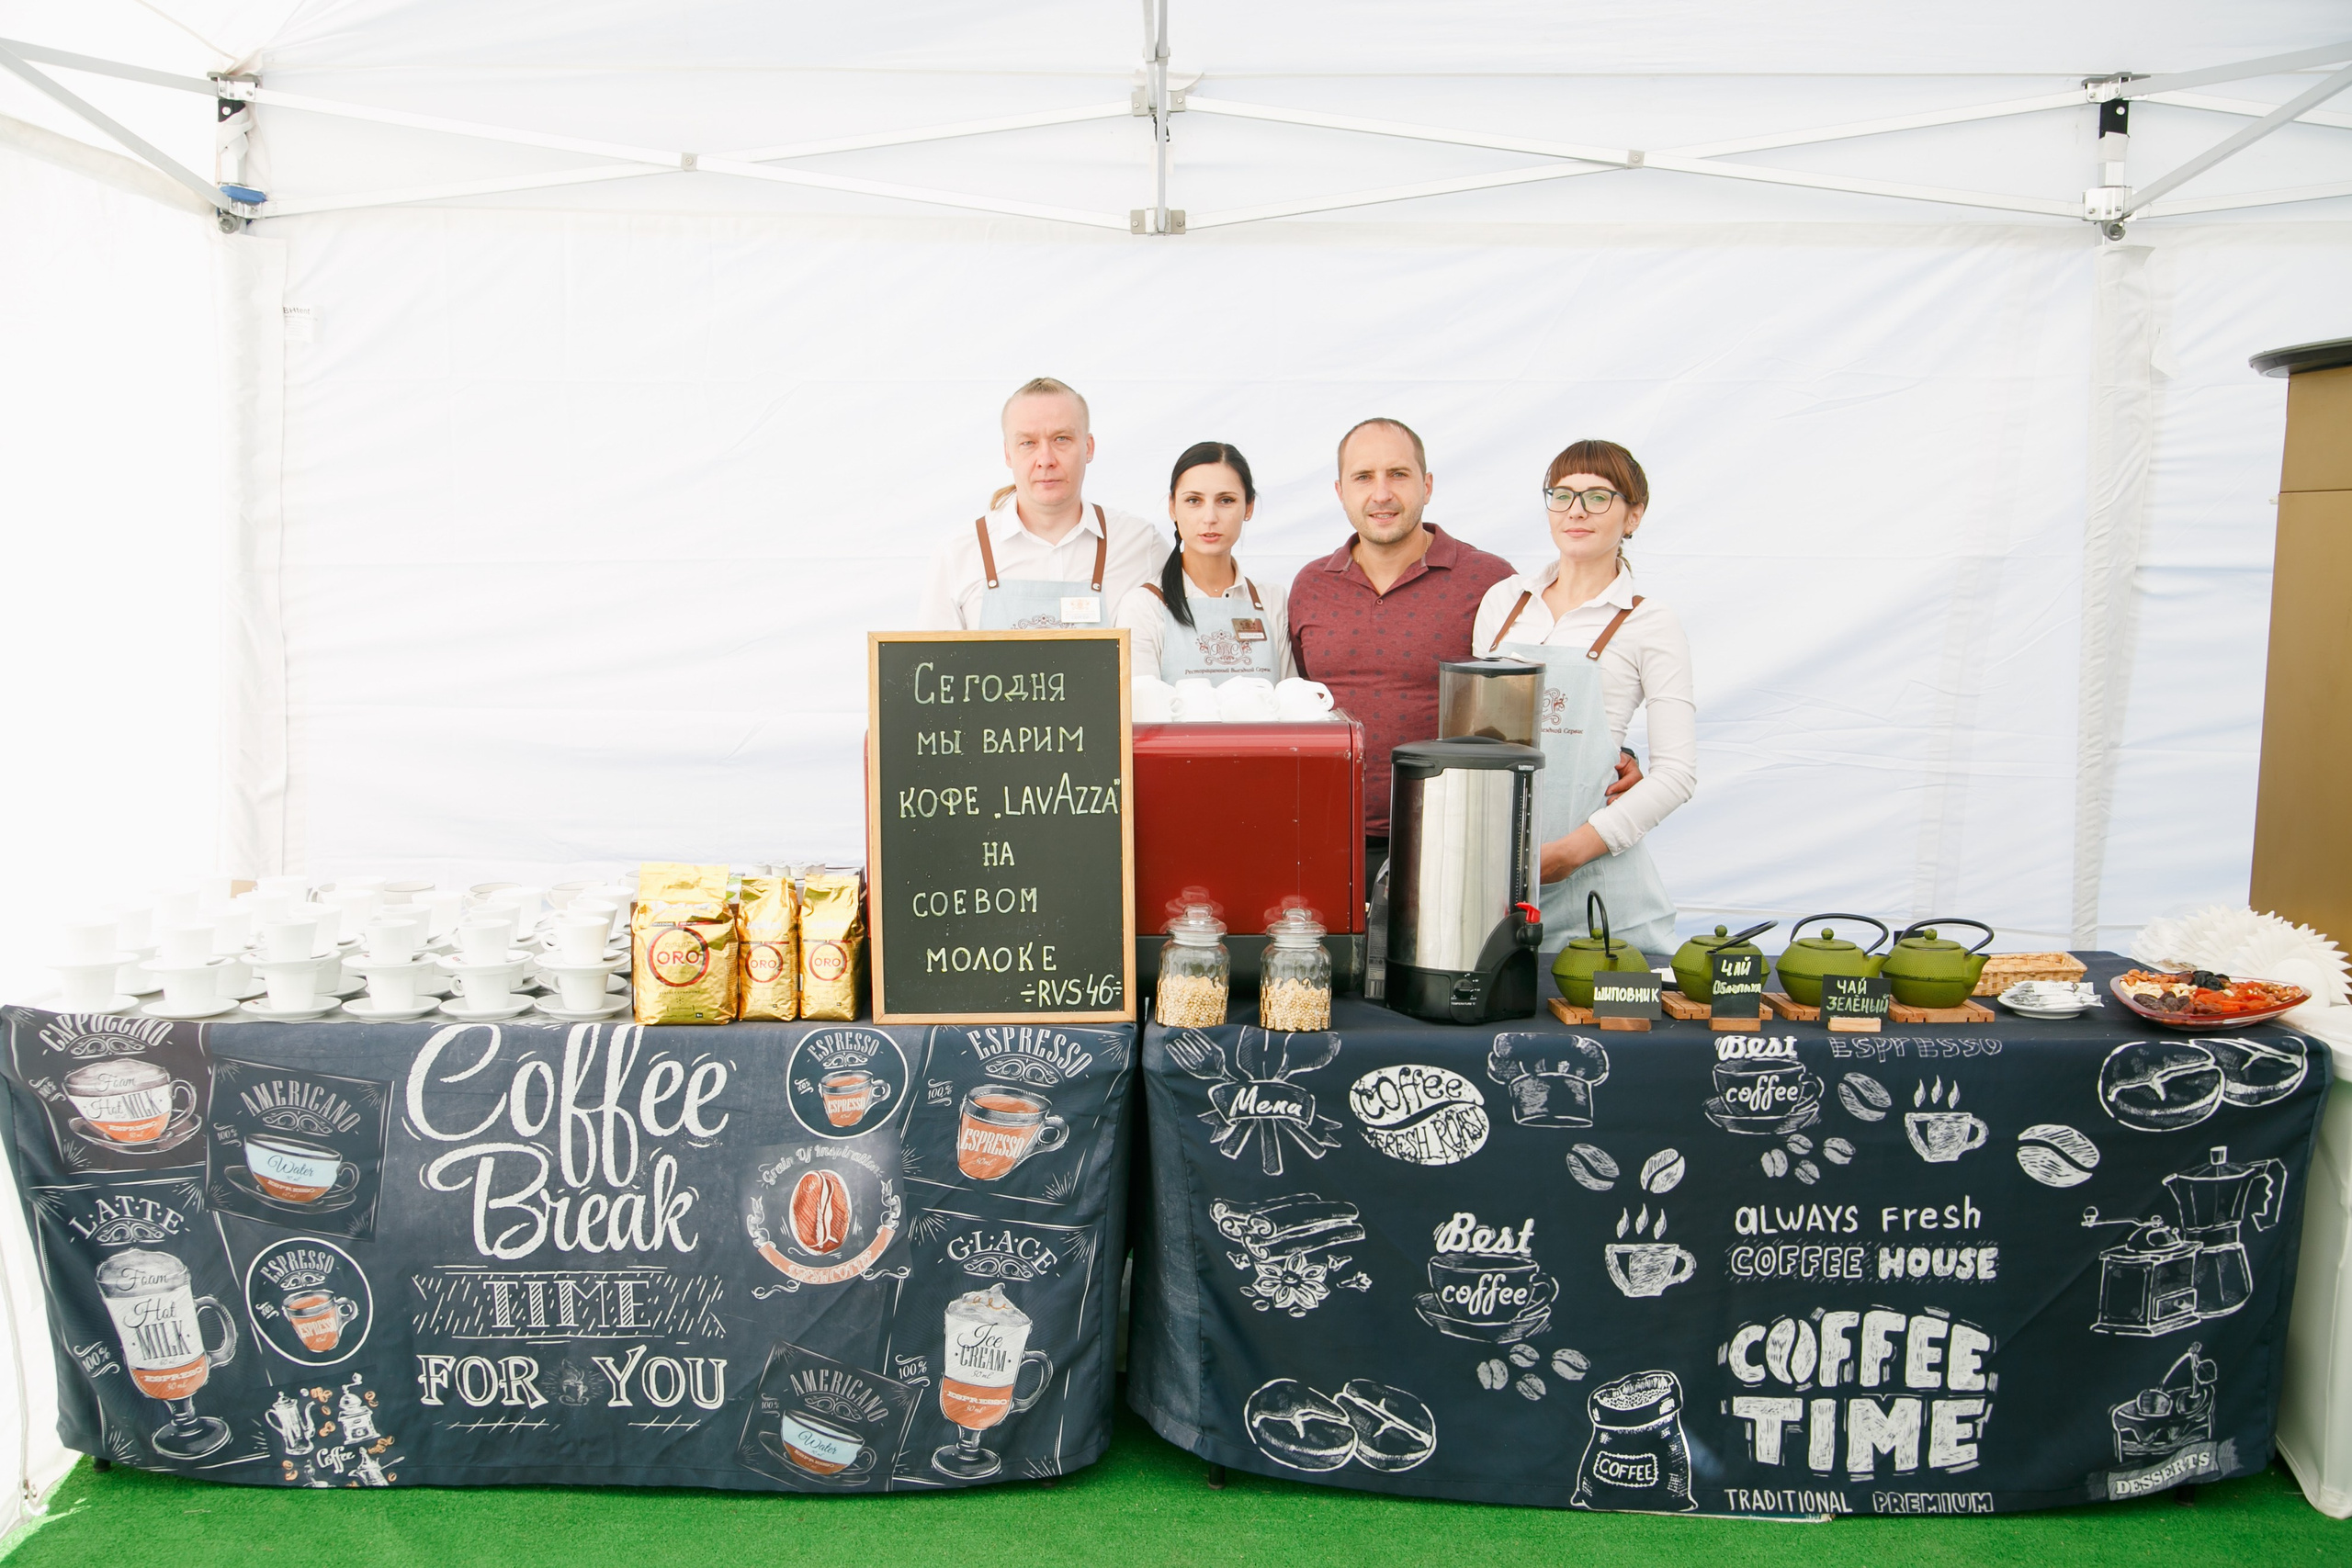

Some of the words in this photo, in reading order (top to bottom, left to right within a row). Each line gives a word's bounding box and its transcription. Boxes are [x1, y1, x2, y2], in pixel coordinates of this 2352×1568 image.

[657, 950, 699, 965] ORO
[751, 959, 776, 968] ORO
[814, 957, 841, 967] ORO
[1721, 956, 1751, 976] ЧАЙ
[1593, 987, 1660, 1003] ШИПОВНИК
[1837, 976, 1867, 994] ЧАЙ
[807, 1032, 880, 1063] ESPRESSO
[967, 1026, 1092, 1078] ESPRESSO
[1716, 1035, 1798, 1060] Best
[95, 1073, 137, 1092] Foam
[927, 1086, 953, 1100] 100%
[1725, 1075, 1799, 1111] coffee
[85, 1099, 123, 1119] Hot
[122, 1089, 162, 1119] MILK
[240, 1080, 361, 1133] AMERICANO
[406, 1023, 729, 1188] Coffee
[828, 1097, 865, 1114] ESPRESSO
[217, 1128, 238, 1141] 100%
[960, 1128, 1025, 1159] ESPRESSO
[267, 1155, 314, 1177] Water
[762, 1156, 794, 1185] Grain
[427, 1142, 699, 1259] Break
[1435, 1213, 1535, 1256] Best
[260, 1249, 335, 1284] ESPRESSO
[1731, 1245, 1864, 1279] COFFEE
[1878, 1246, 1999, 1280] HOUSE
[116, 1268, 169, 1291] Foam
[1442, 1273, 1528, 1314] coffee
[123, 1298, 177, 1328] Hot
[482, 1280, 650, 1328] TIME
[135, 1320, 191, 1360] MILK
[297, 1317, 337, 1338] ESPRESSO
[956, 1323, 1003, 1348] Ice
[81, 1347, 111, 1373] 100%
[959, 1344, 1007, 1372] CREAM
[1728, 1310, 1991, 1391] COFFEE
[416, 1354, 548, 1409] FOR
[591, 1344, 728, 1410] YOU
[899, 1361, 928, 1379] 100%
[790, 1369, 888, 1423] AMERICANO
[797, 1430, 838, 1455] Water
[1733, 1395, 1986, 1472] TIME
[317, 1446, 356, 1474] Coffee
[1599, 1458, 1654, 1481] COFFEE
[2115, 1450, 2211, 1496] DESSERTS
[1724, 1489, 1853, 1513] TRADITIONAL
[1872, 1491, 1994, 1514] PREMIUM
